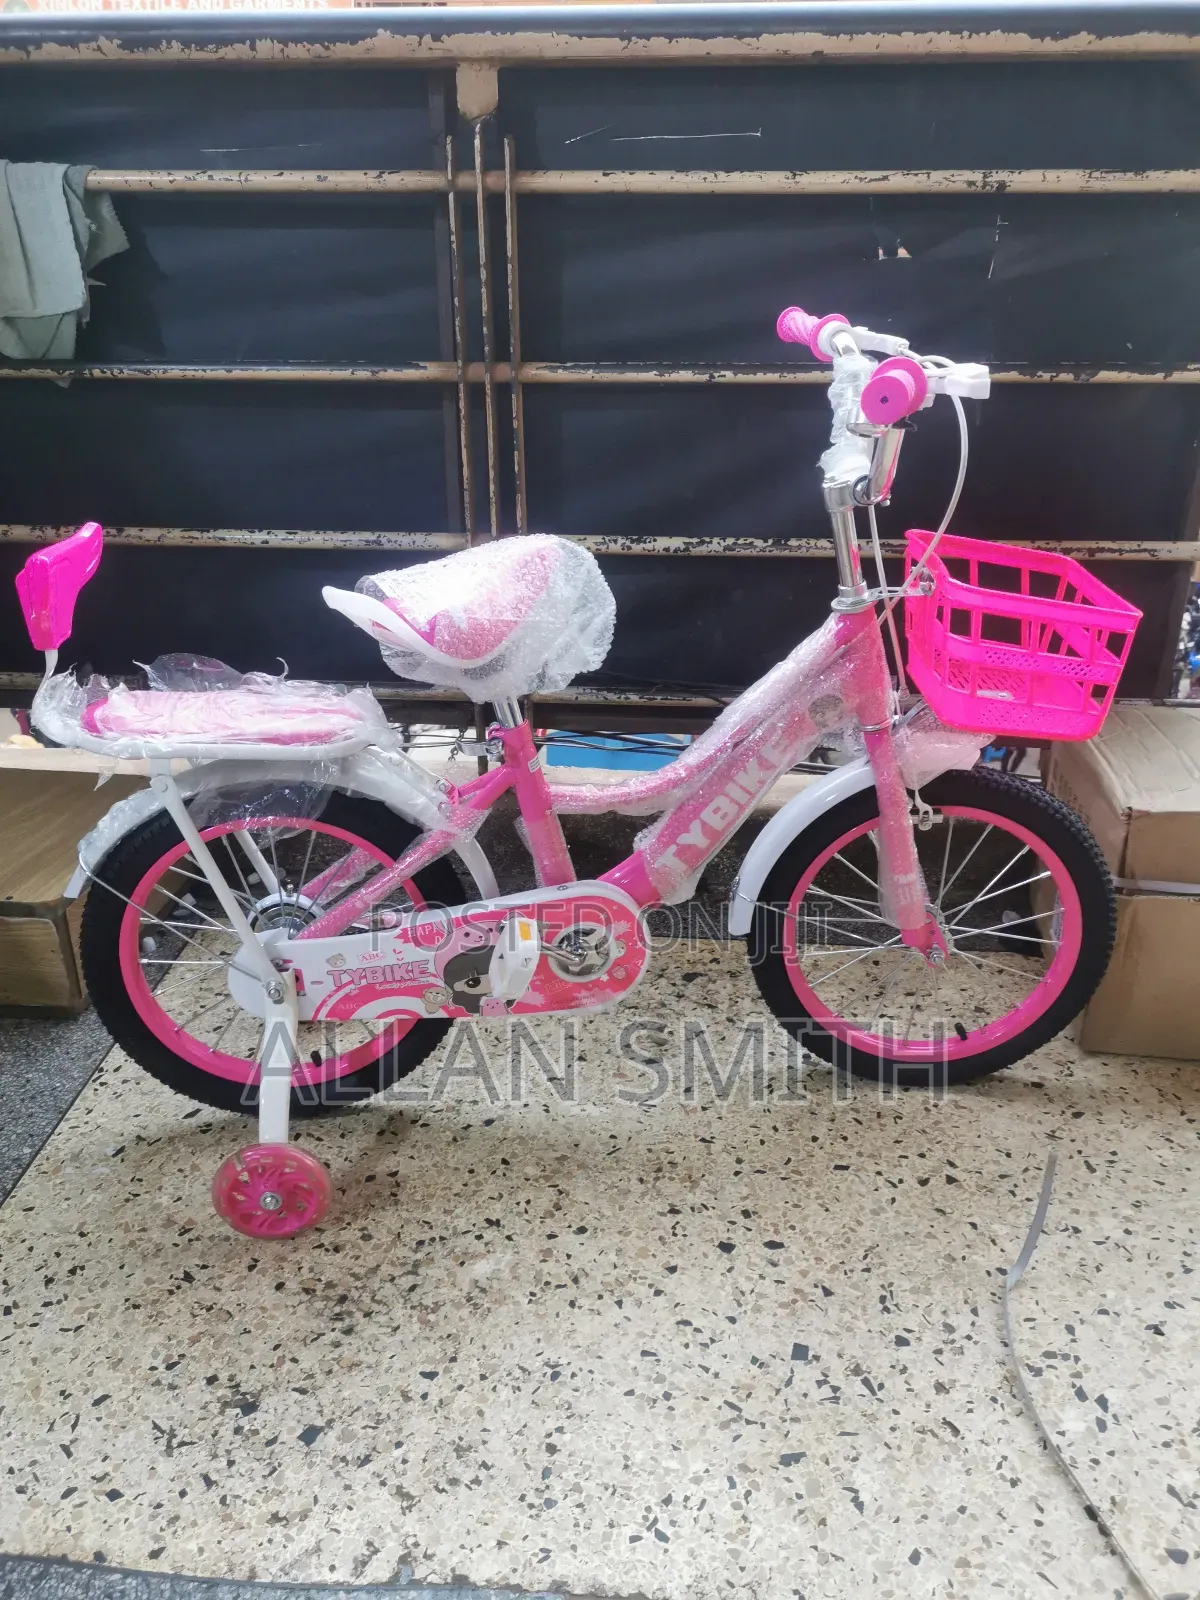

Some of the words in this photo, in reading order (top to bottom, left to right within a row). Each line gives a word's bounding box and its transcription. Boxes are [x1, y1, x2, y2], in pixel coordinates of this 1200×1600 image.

[107, 0, 182, 11] TEXTILE
[188, 0, 222, 10] AND
[229, 0, 329, 9] GARMENTS
[654, 732, 793, 877] TYBIKE
[327, 959, 431, 987] TYBIKE
